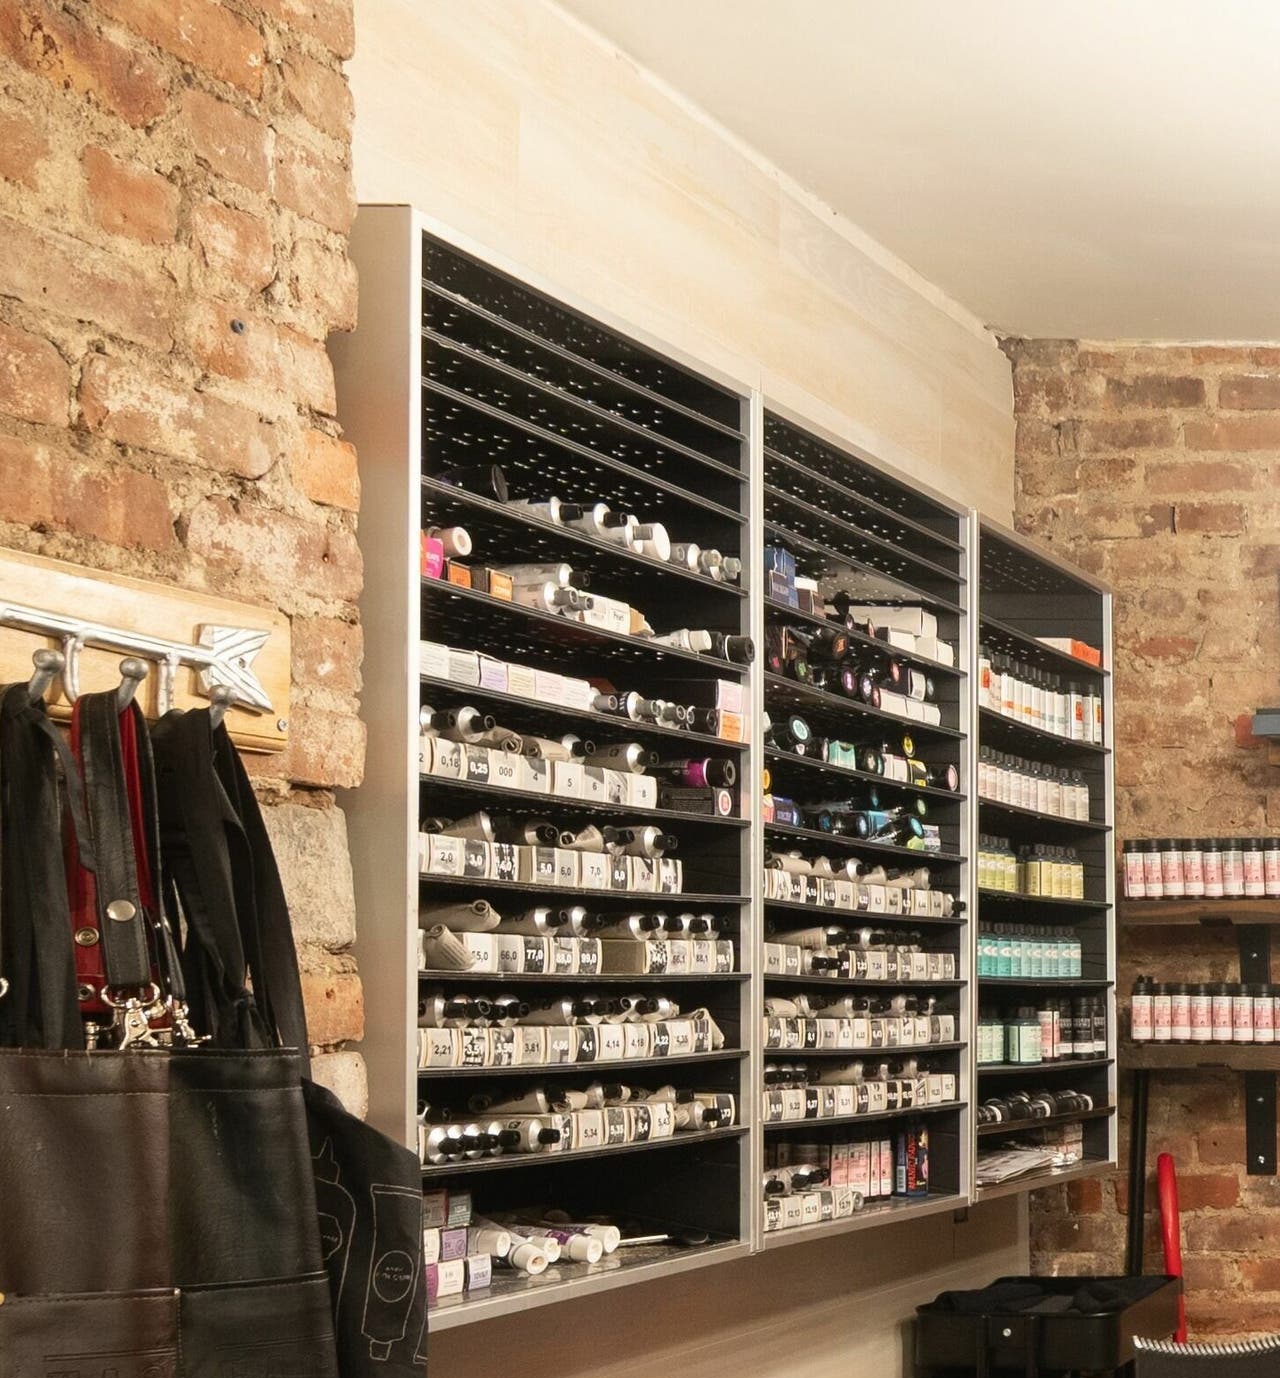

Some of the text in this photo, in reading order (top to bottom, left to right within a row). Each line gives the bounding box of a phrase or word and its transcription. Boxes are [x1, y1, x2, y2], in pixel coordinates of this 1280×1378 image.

[470, 761, 488, 775] 0,25
[541, 863, 553, 876] 5,0
[500, 951, 517, 961] 66,0
[526, 949, 543, 961] 77,0
[434, 1045, 451, 1056] 2,21
